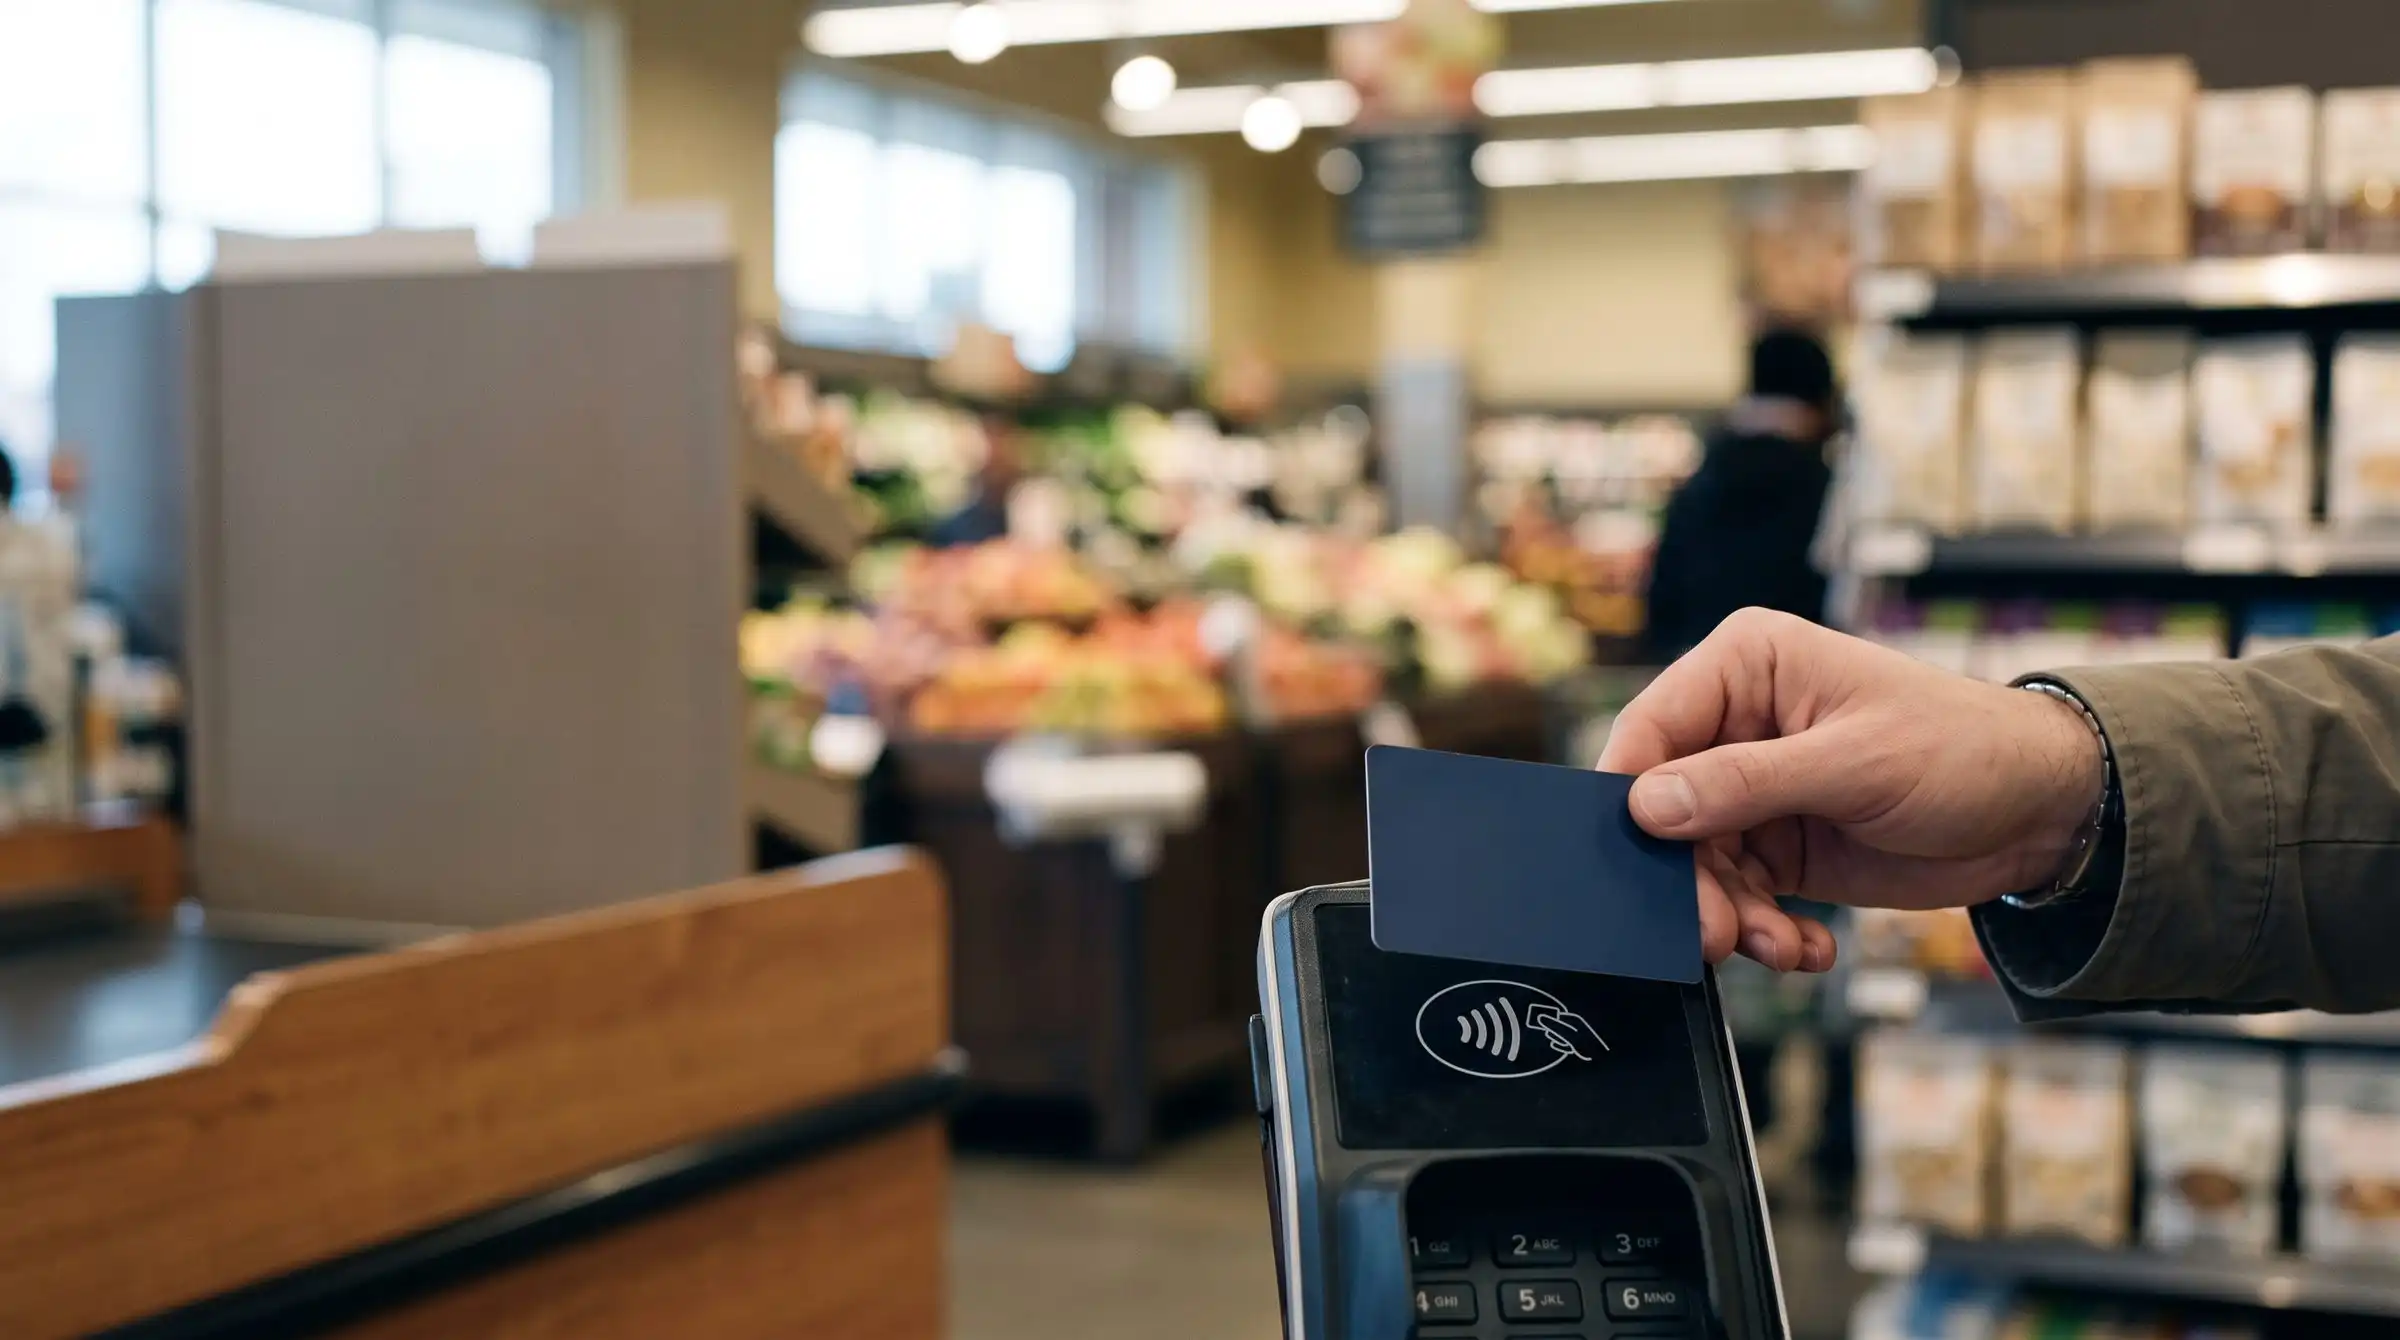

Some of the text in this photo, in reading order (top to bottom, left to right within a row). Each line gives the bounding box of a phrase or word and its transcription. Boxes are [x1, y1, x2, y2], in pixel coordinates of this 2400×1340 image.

[1410, 1236, 1420, 1256] 1
[1512, 1234, 1560, 1255] 2 ABC
[1616, 1233, 1661, 1254] 3 DEF
[1416, 1290, 1458, 1313] 4 GHI
[1519, 1288, 1565, 1311] 5 JKL
[1622, 1287, 1676, 1310] 6 MNO
